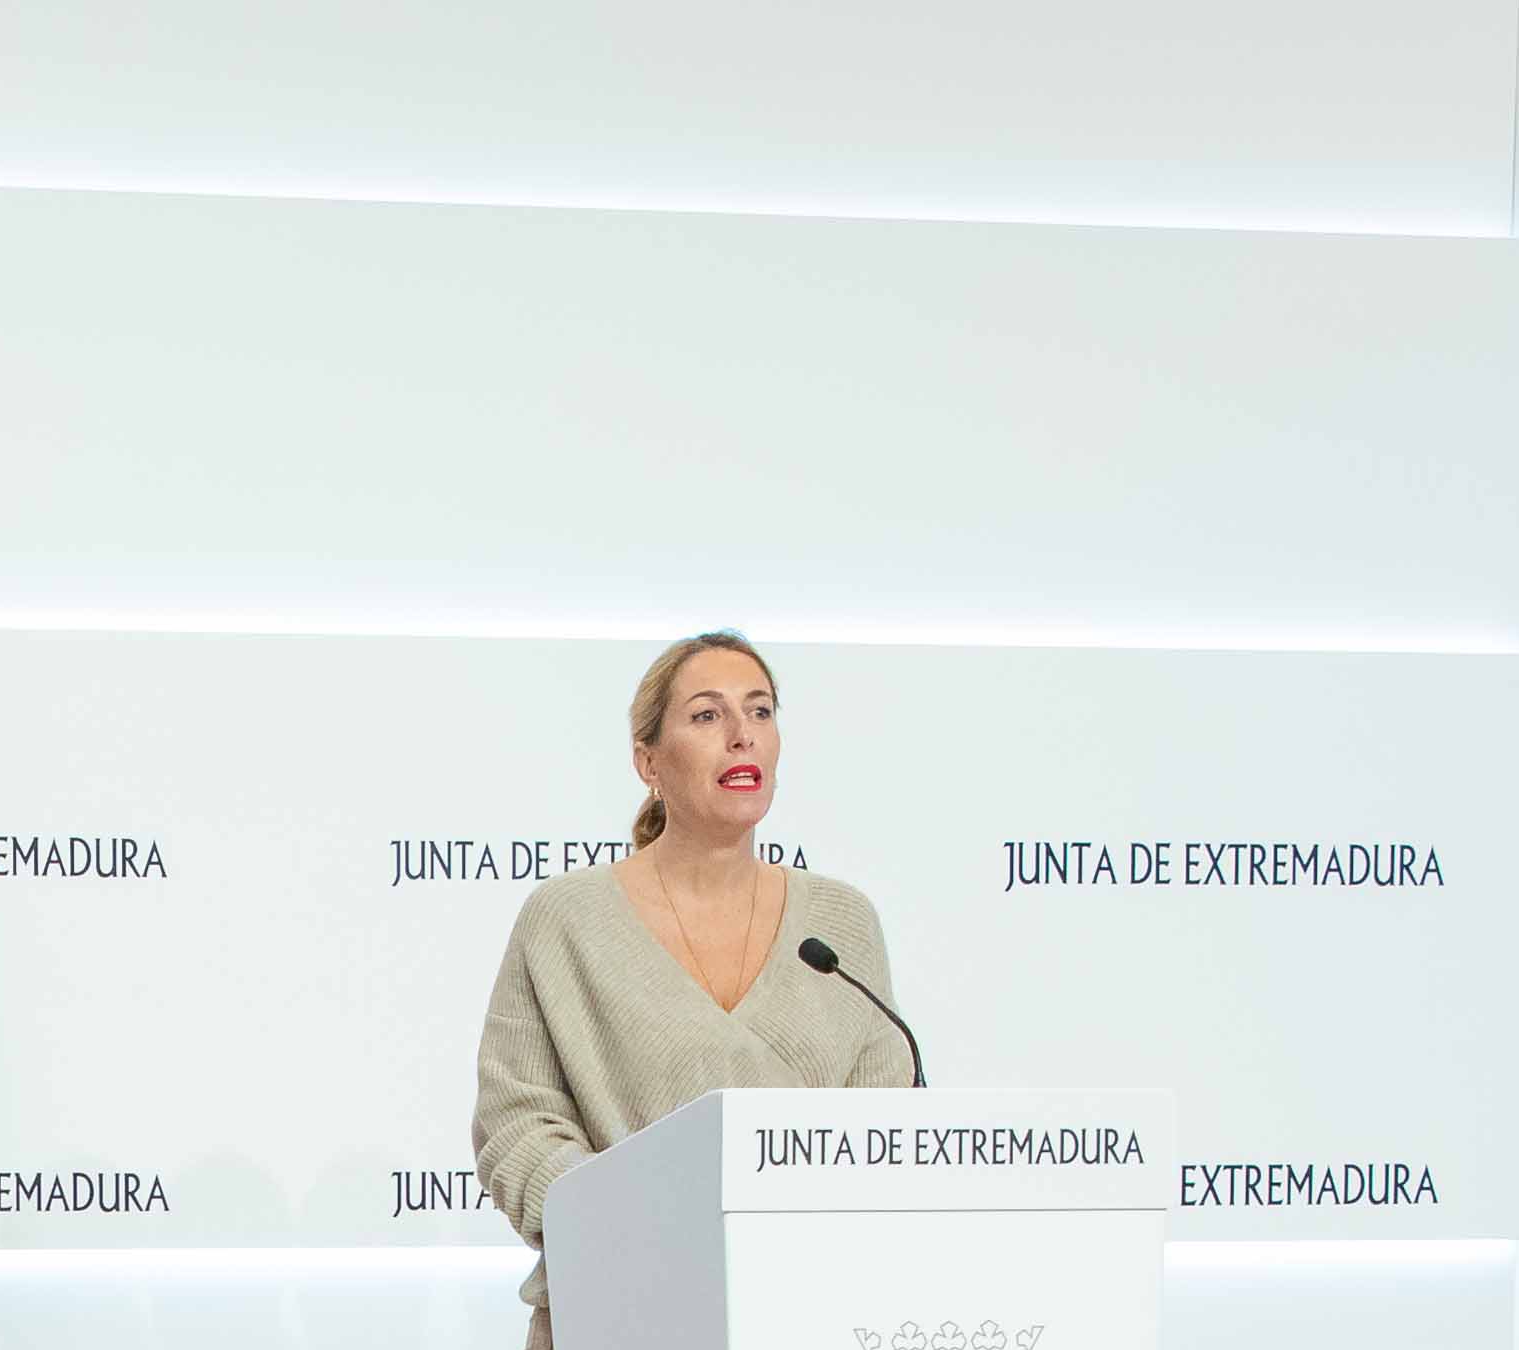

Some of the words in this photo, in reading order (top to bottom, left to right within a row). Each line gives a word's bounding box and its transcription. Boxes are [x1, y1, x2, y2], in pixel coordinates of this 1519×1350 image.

[390, 840, 498, 887] JUNTA
[512, 841, 550, 881] DE
[1003, 842, 1117, 892] JUNTA
[1131, 843, 1171, 886] DE
[1185, 843, 1444, 887] EXTREMADURA
[755, 1129, 856, 1173] JUNTA
[867, 1129, 903, 1165] DE
[915, 1128, 1144, 1165] EXTREMADURA
[1180, 1163, 1438, 1206] EXTREMADURA
